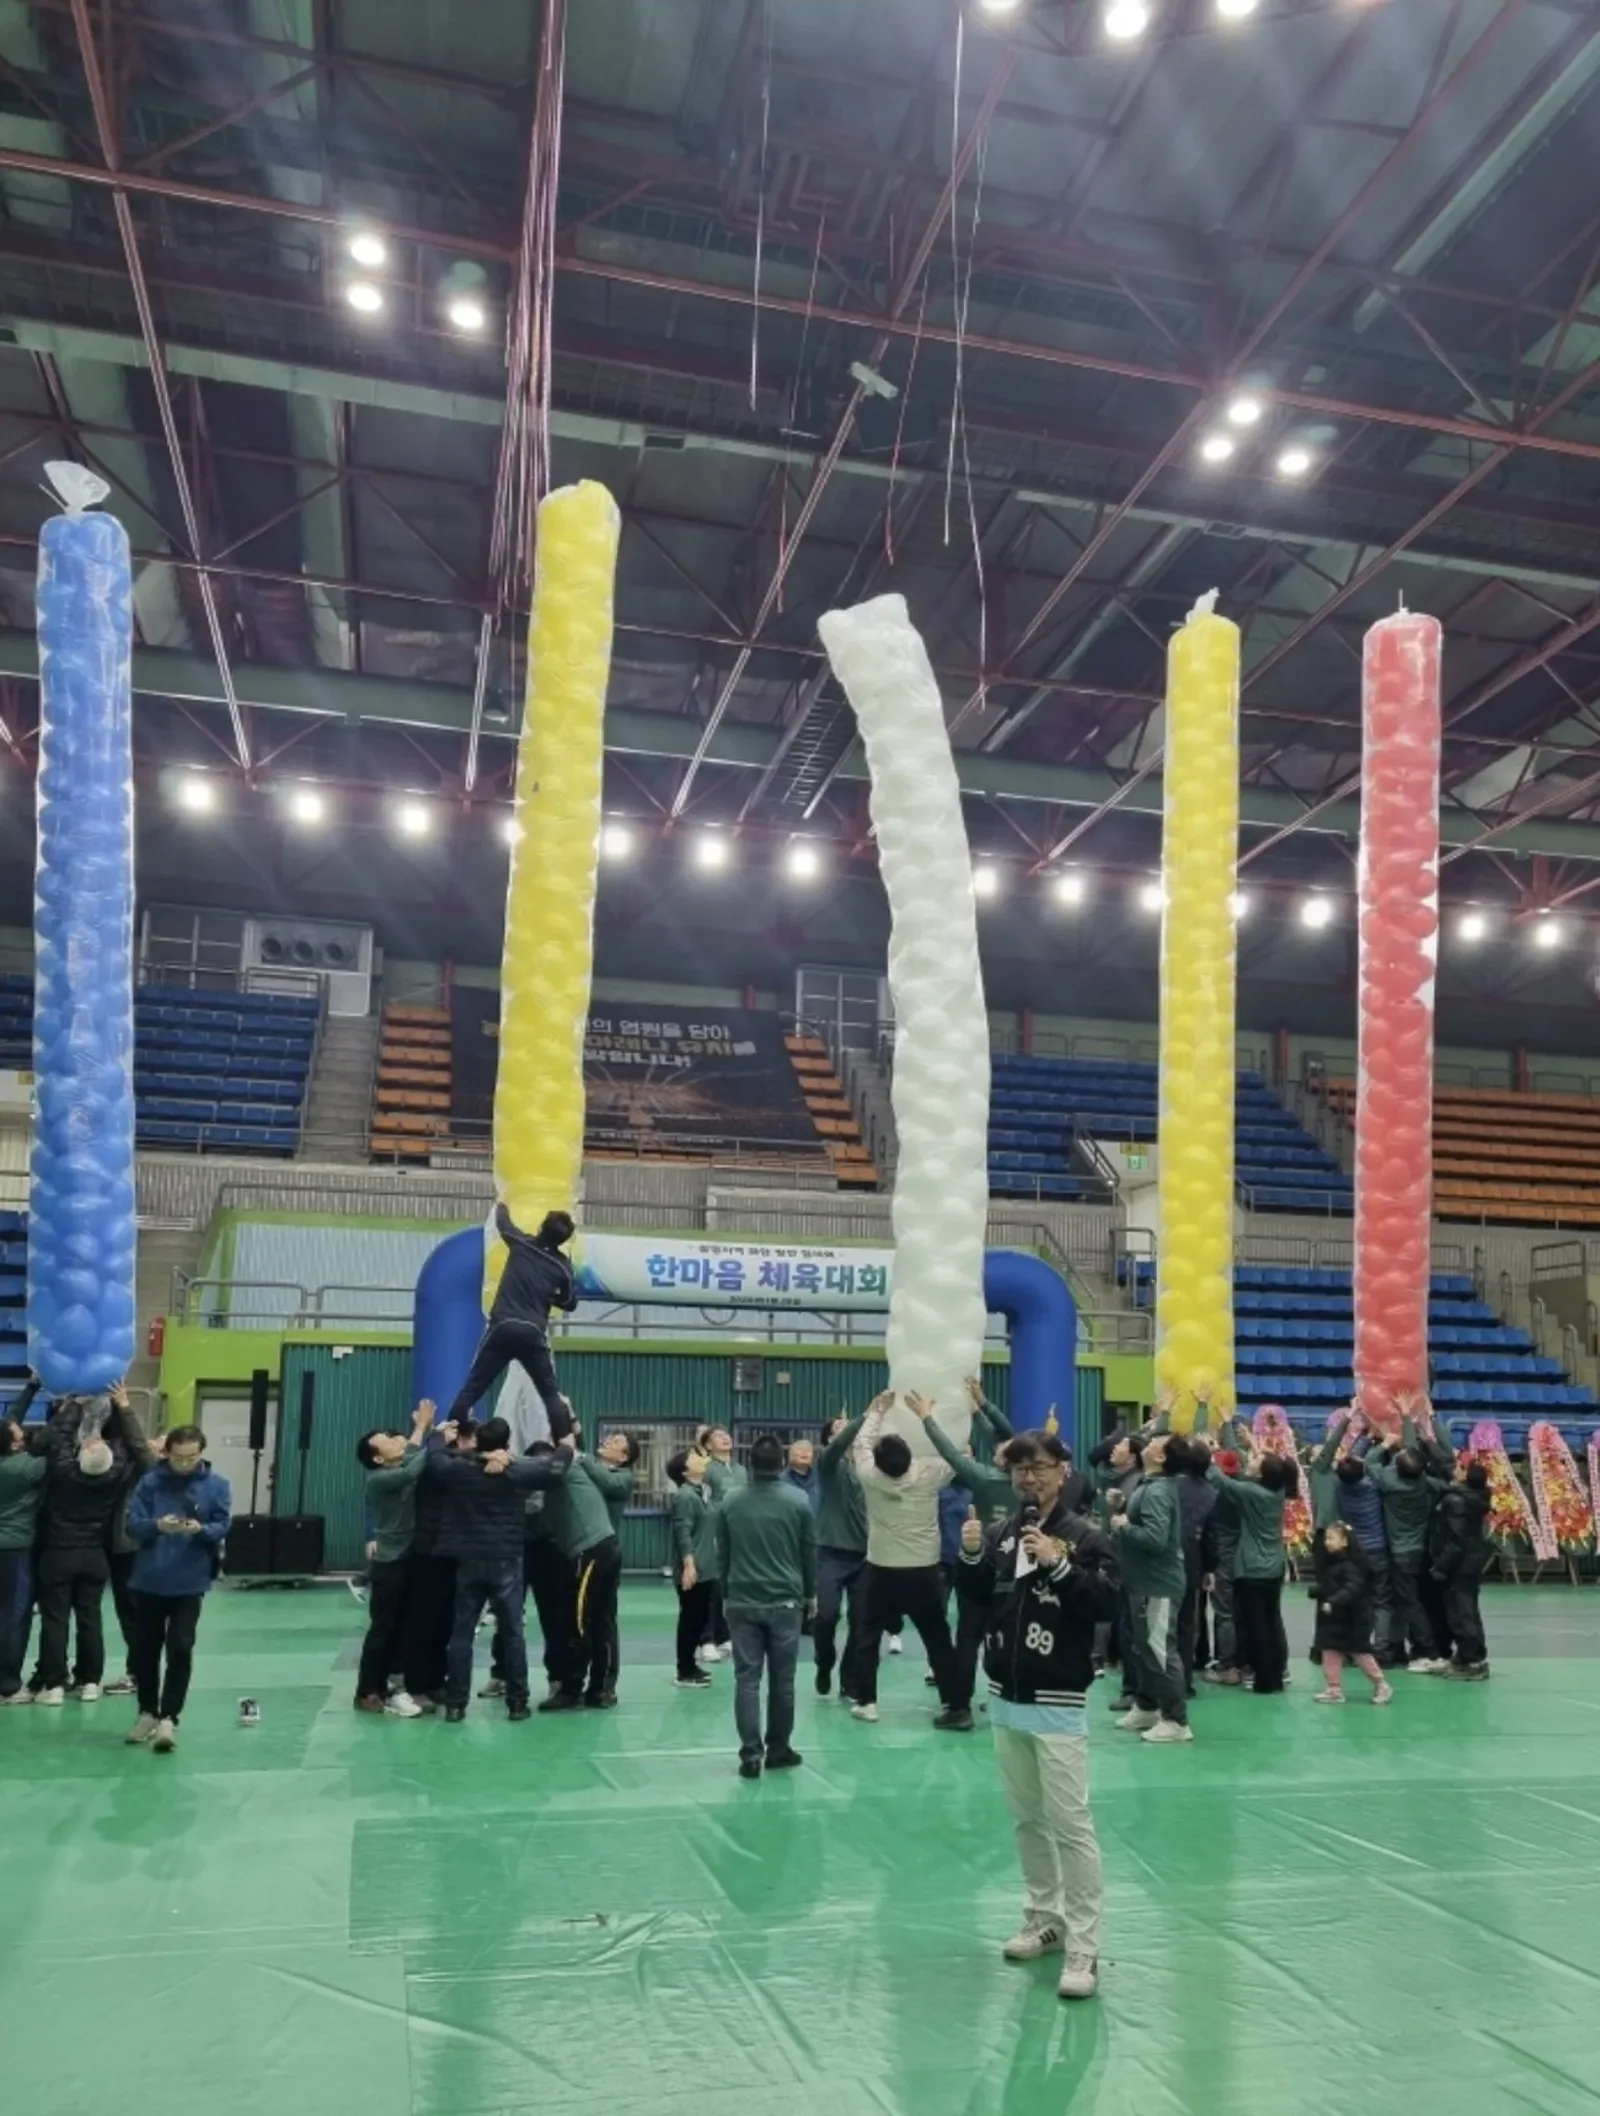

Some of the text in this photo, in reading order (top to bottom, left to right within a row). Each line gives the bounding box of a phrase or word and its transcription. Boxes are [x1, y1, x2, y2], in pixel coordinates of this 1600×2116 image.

[646, 1254, 888, 1297] 한마음 체육대회
[1025, 1622, 1054, 1656] 89
